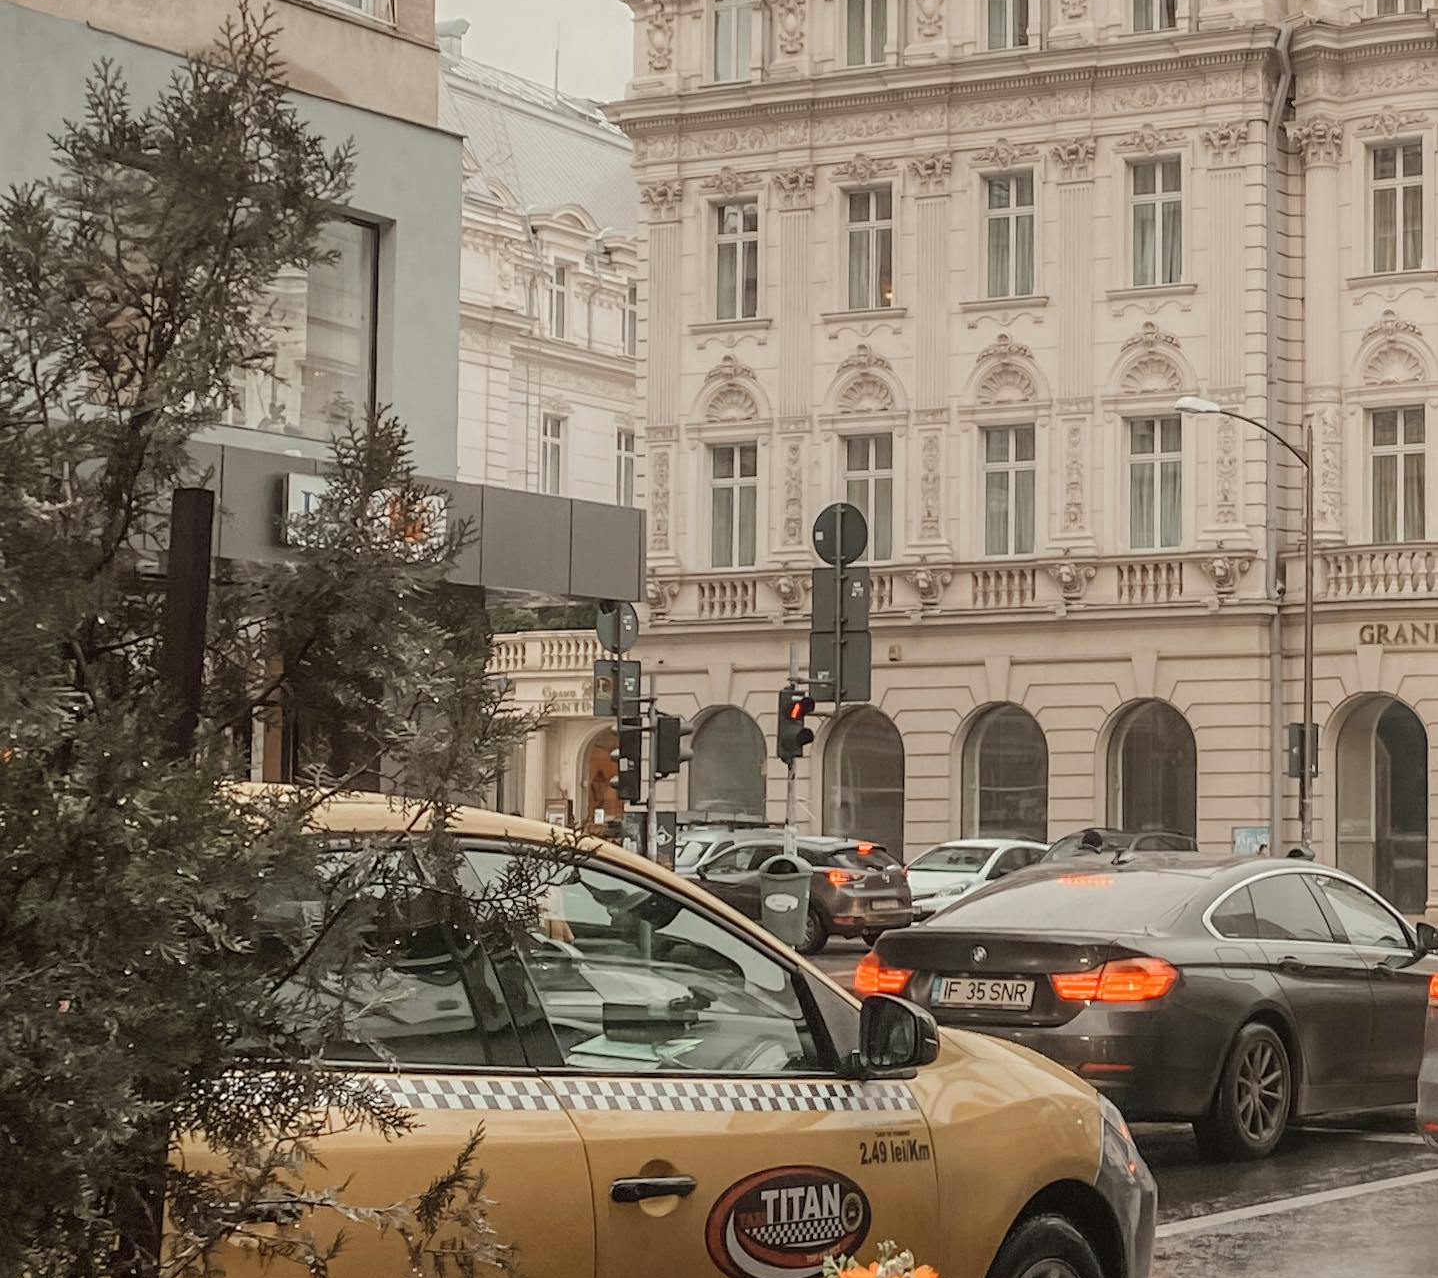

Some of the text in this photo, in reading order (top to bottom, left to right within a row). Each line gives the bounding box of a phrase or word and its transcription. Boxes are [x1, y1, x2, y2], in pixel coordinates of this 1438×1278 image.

[944, 981, 1027, 1002] IF 35 SNR
[859, 1139, 930, 1165] 2.49 lei/Km
[760, 1183, 841, 1225] TITAN
